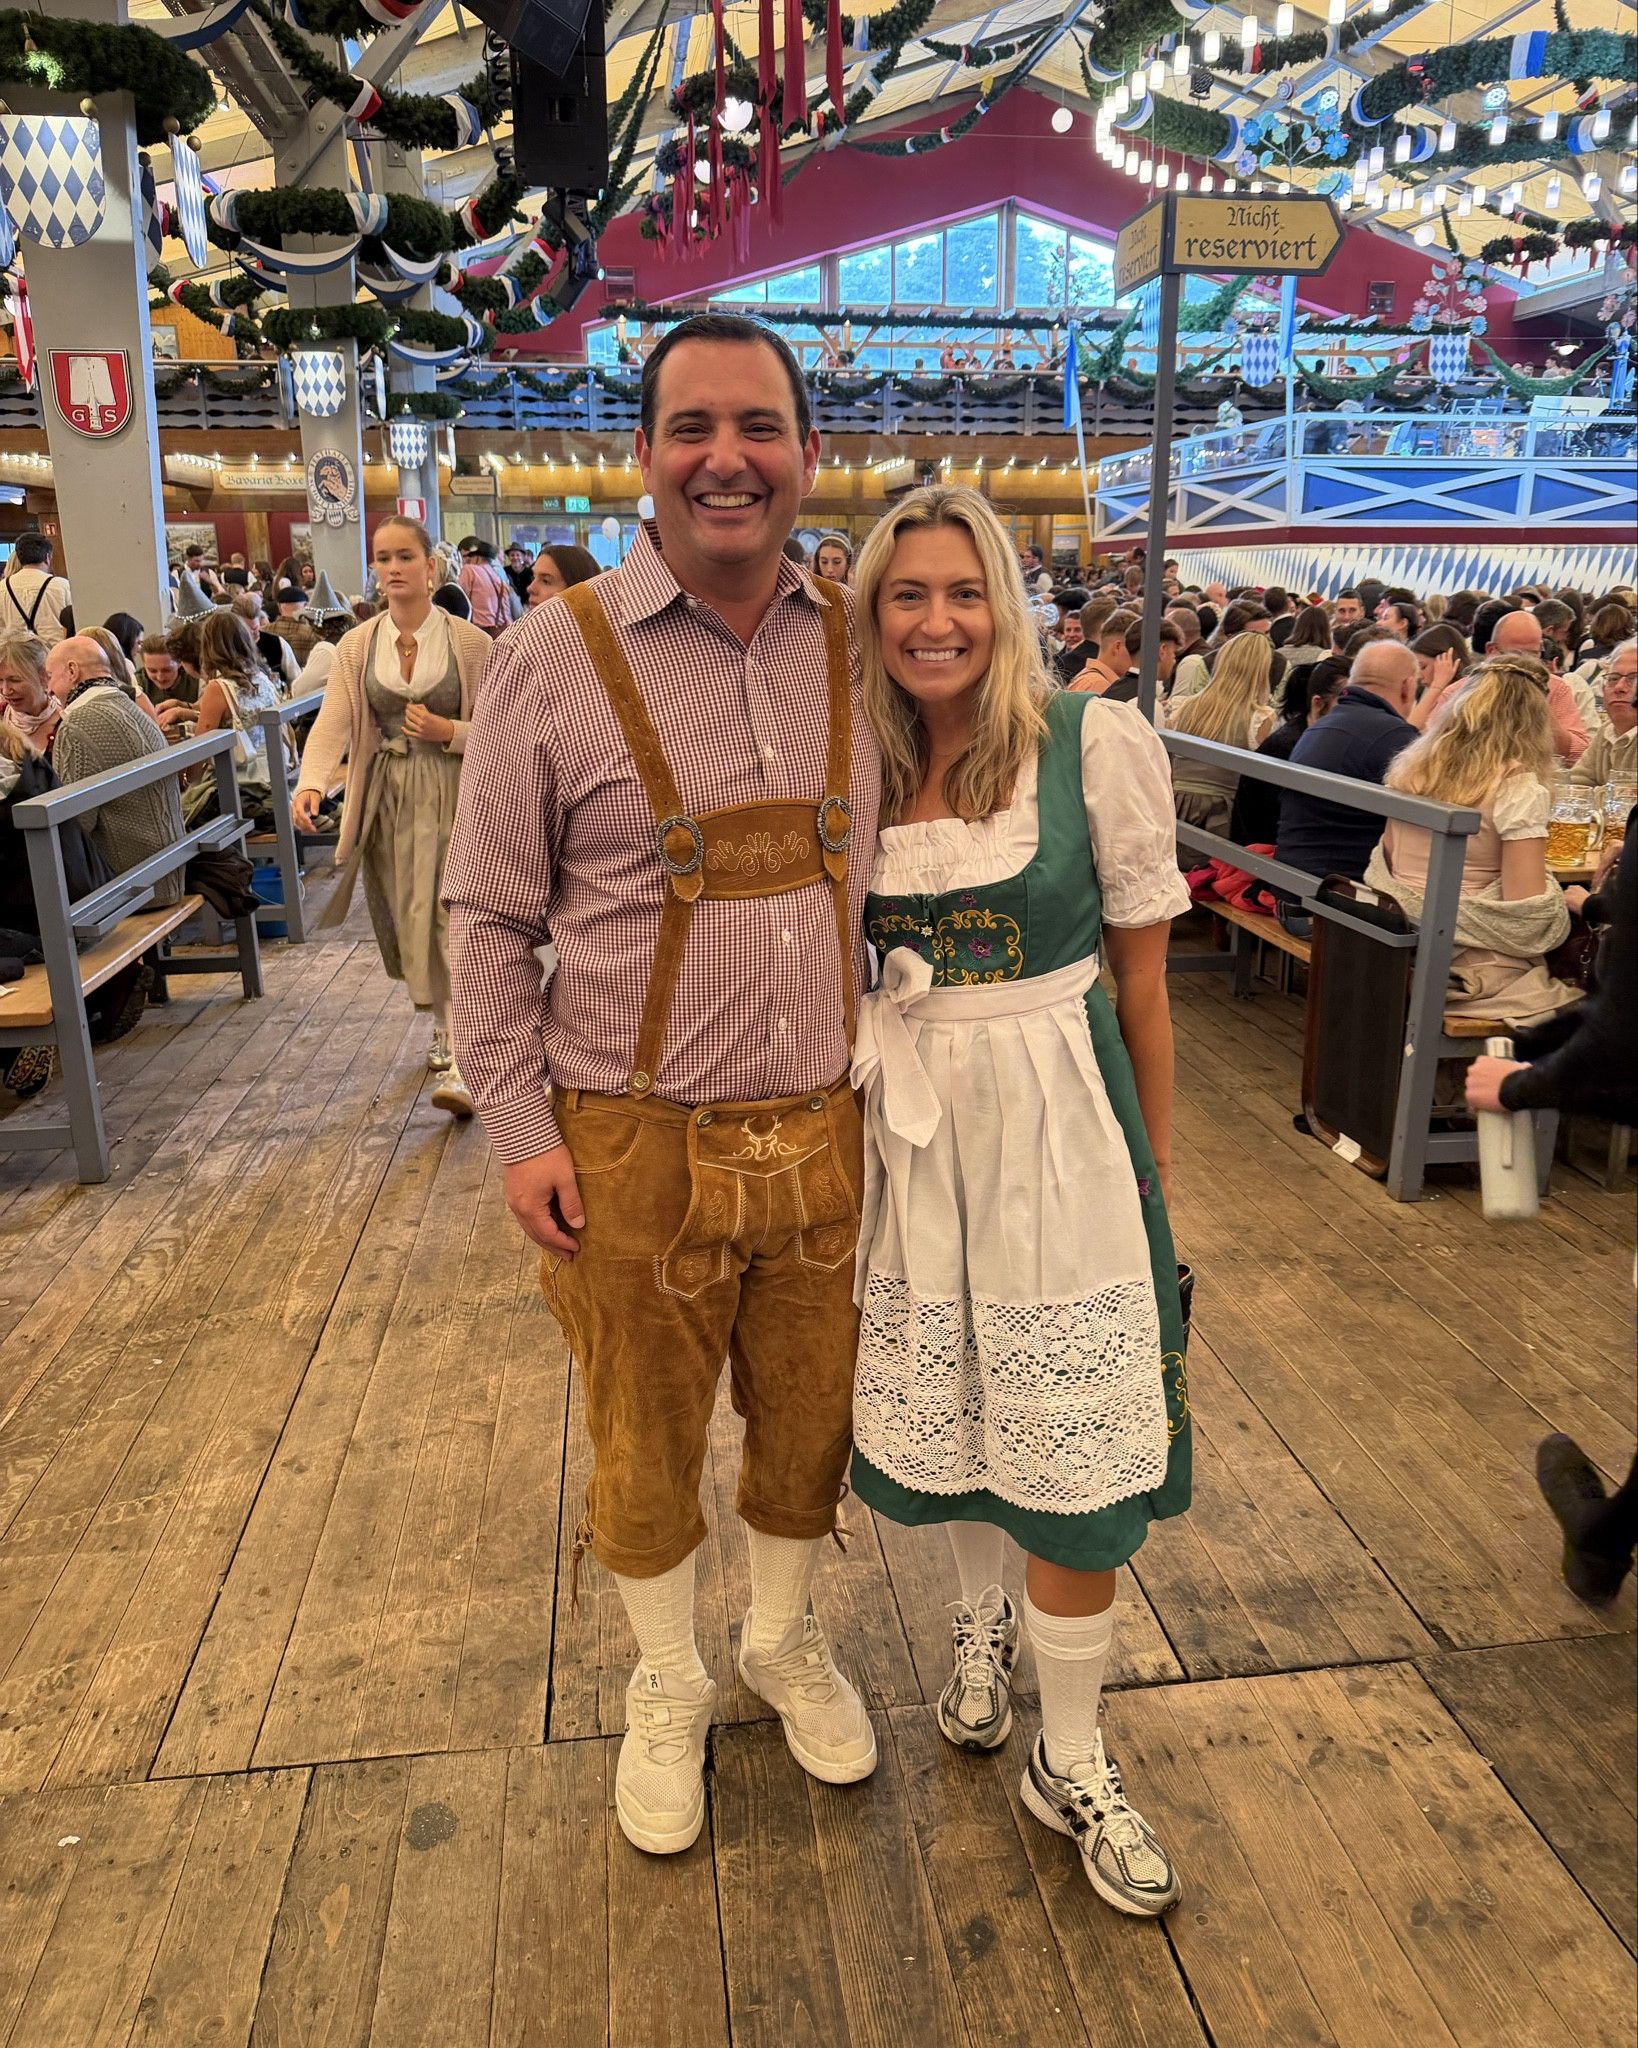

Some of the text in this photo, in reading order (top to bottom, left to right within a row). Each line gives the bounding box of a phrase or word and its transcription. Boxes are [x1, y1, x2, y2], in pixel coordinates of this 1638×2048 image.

[1226, 204, 1280, 231] Nicht
[1184, 230, 1317, 261] reserviert
[71, 409, 117, 423] G S
[225, 474, 273, 485] Bavaria
